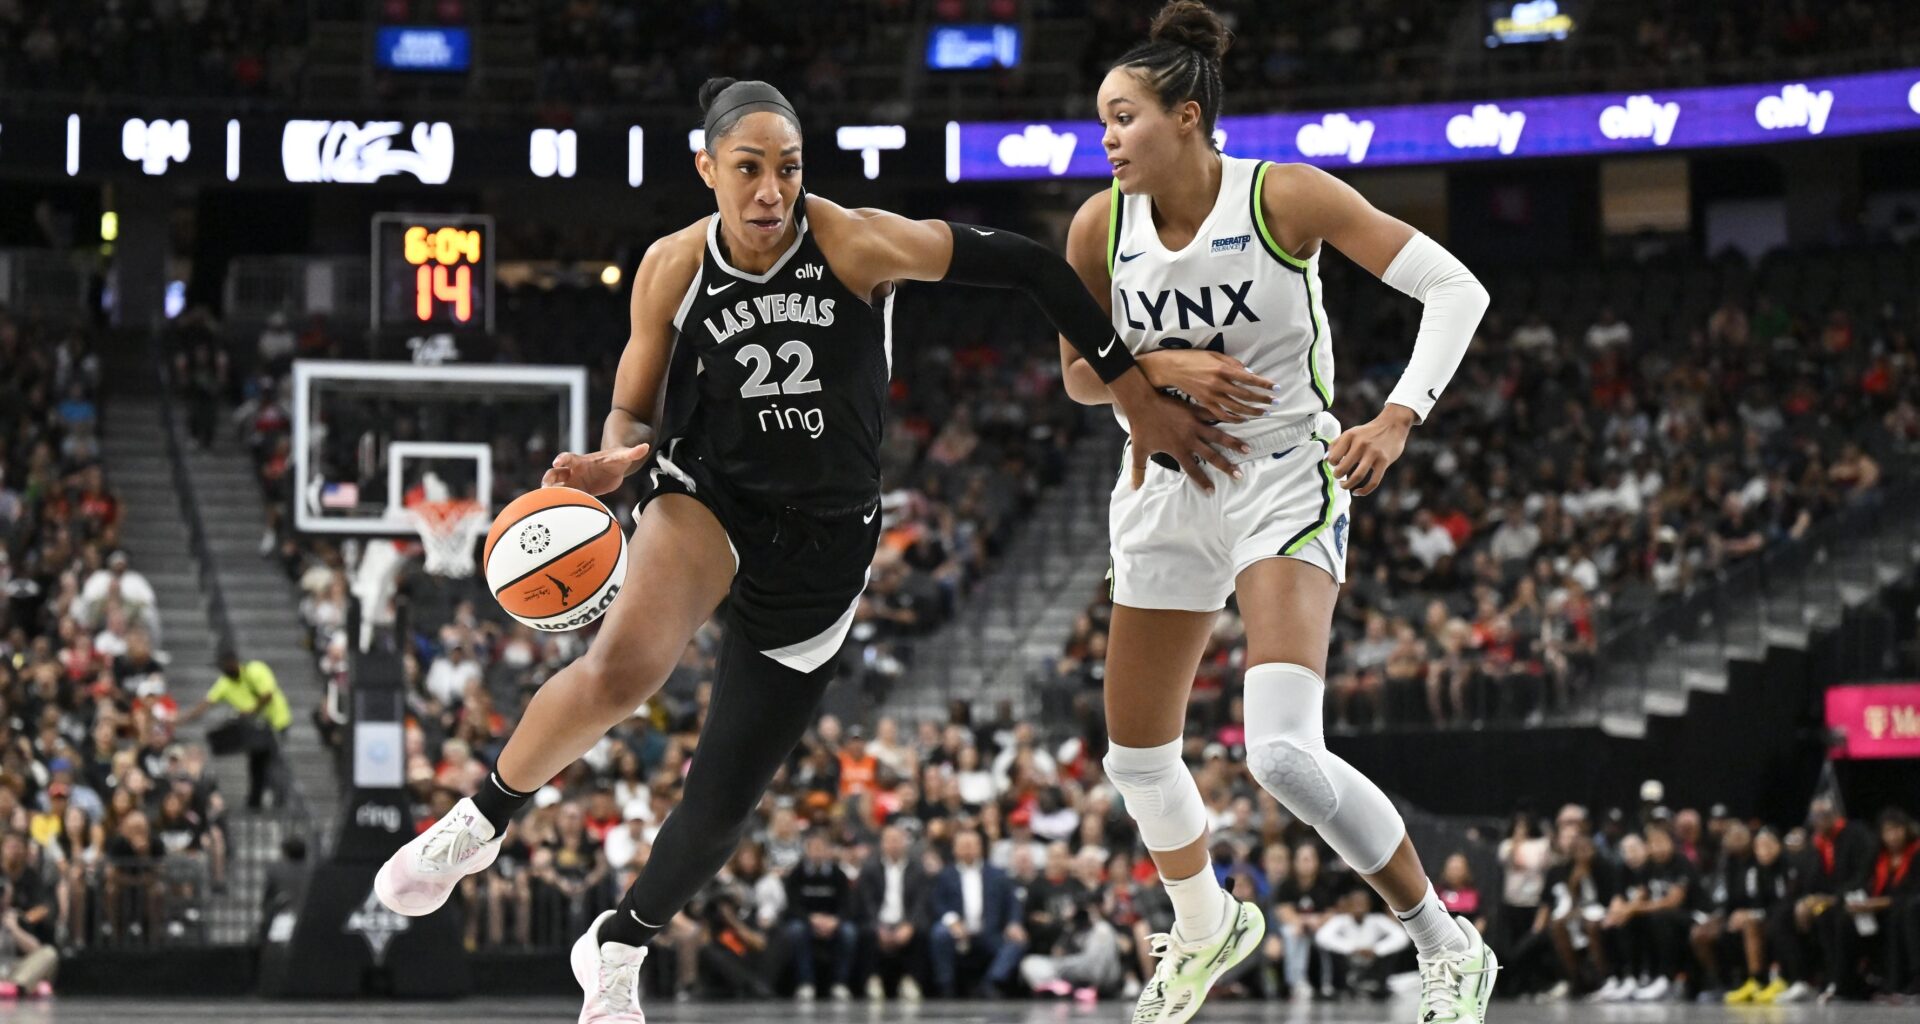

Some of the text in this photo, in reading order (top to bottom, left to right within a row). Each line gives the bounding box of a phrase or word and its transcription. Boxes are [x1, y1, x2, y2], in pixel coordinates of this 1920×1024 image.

[404, 226, 480, 265] 6:04
[1211, 234, 1251, 248] FEDERATED
[416, 264, 471, 322] 14
[795, 263, 824, 281] ally
[703, 292, 836, 344] LAS VEGAS
[1119, 279, 1261, 331] LYNX
[734, 340, 823, 399] 22
[758, 404, 825, 439] ring
